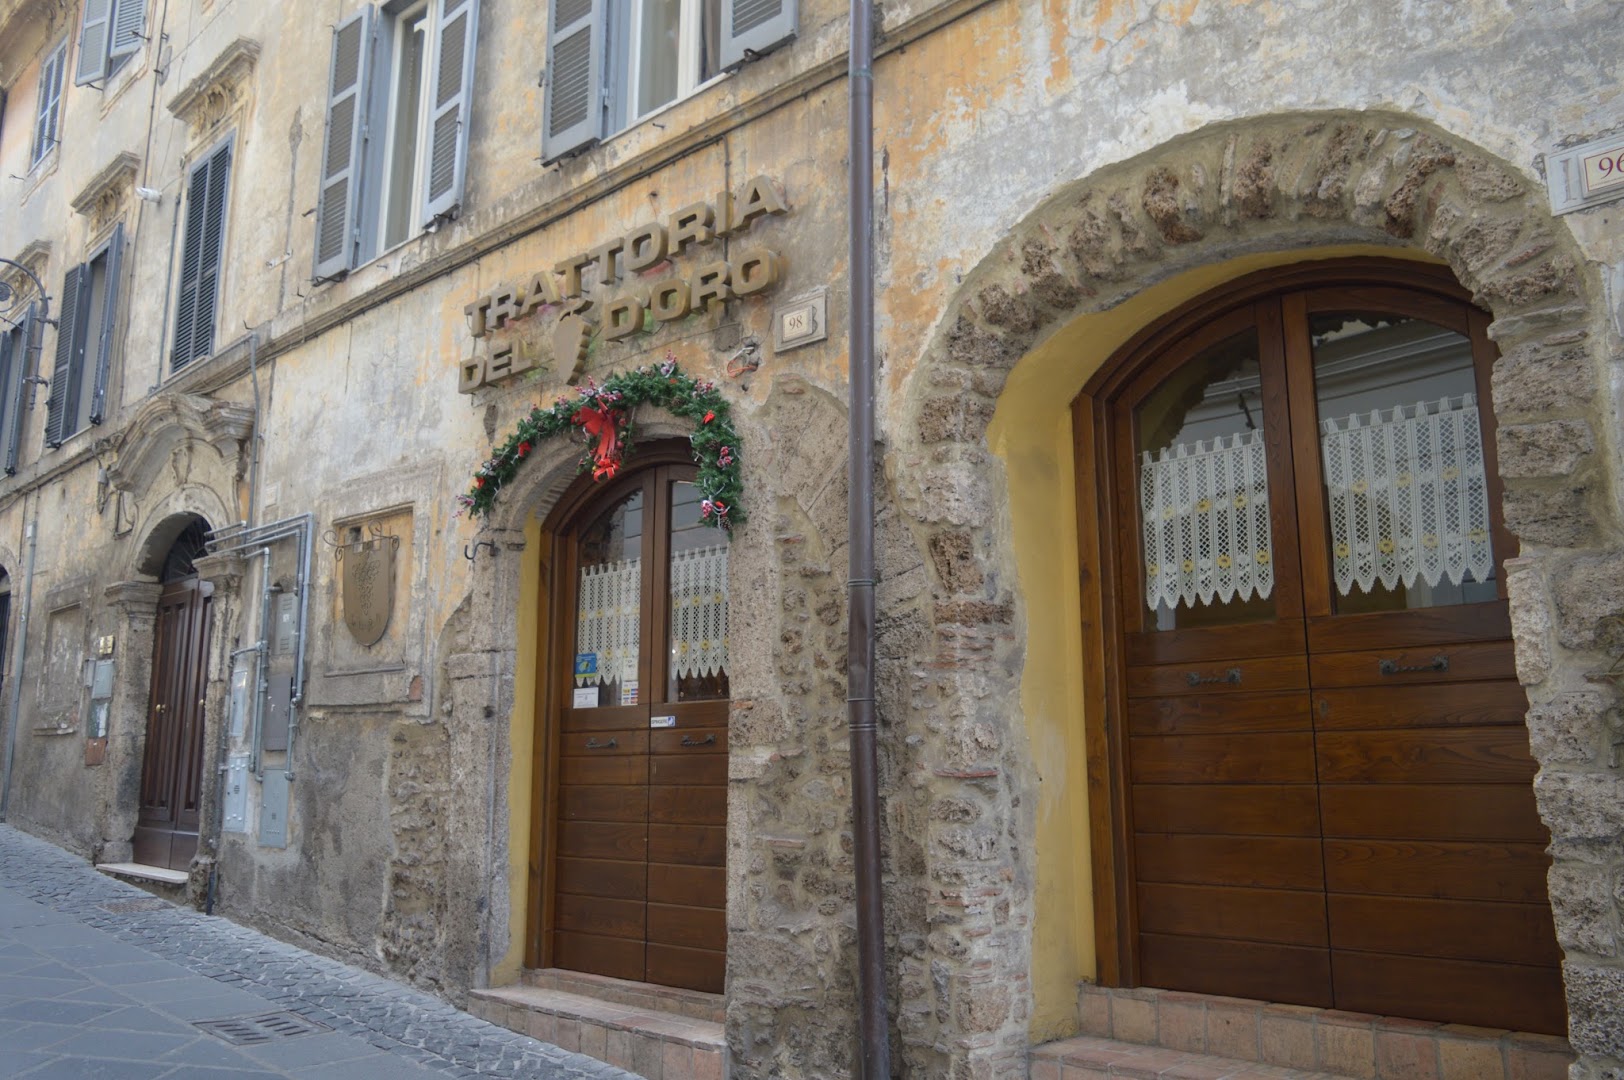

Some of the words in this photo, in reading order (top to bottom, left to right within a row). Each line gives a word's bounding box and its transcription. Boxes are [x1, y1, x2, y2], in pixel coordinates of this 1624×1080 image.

[464, 174, 786, 338] TRATTORIA
[789, 314, 803, 330] 98
[458, 334, 541, 395] DEL
